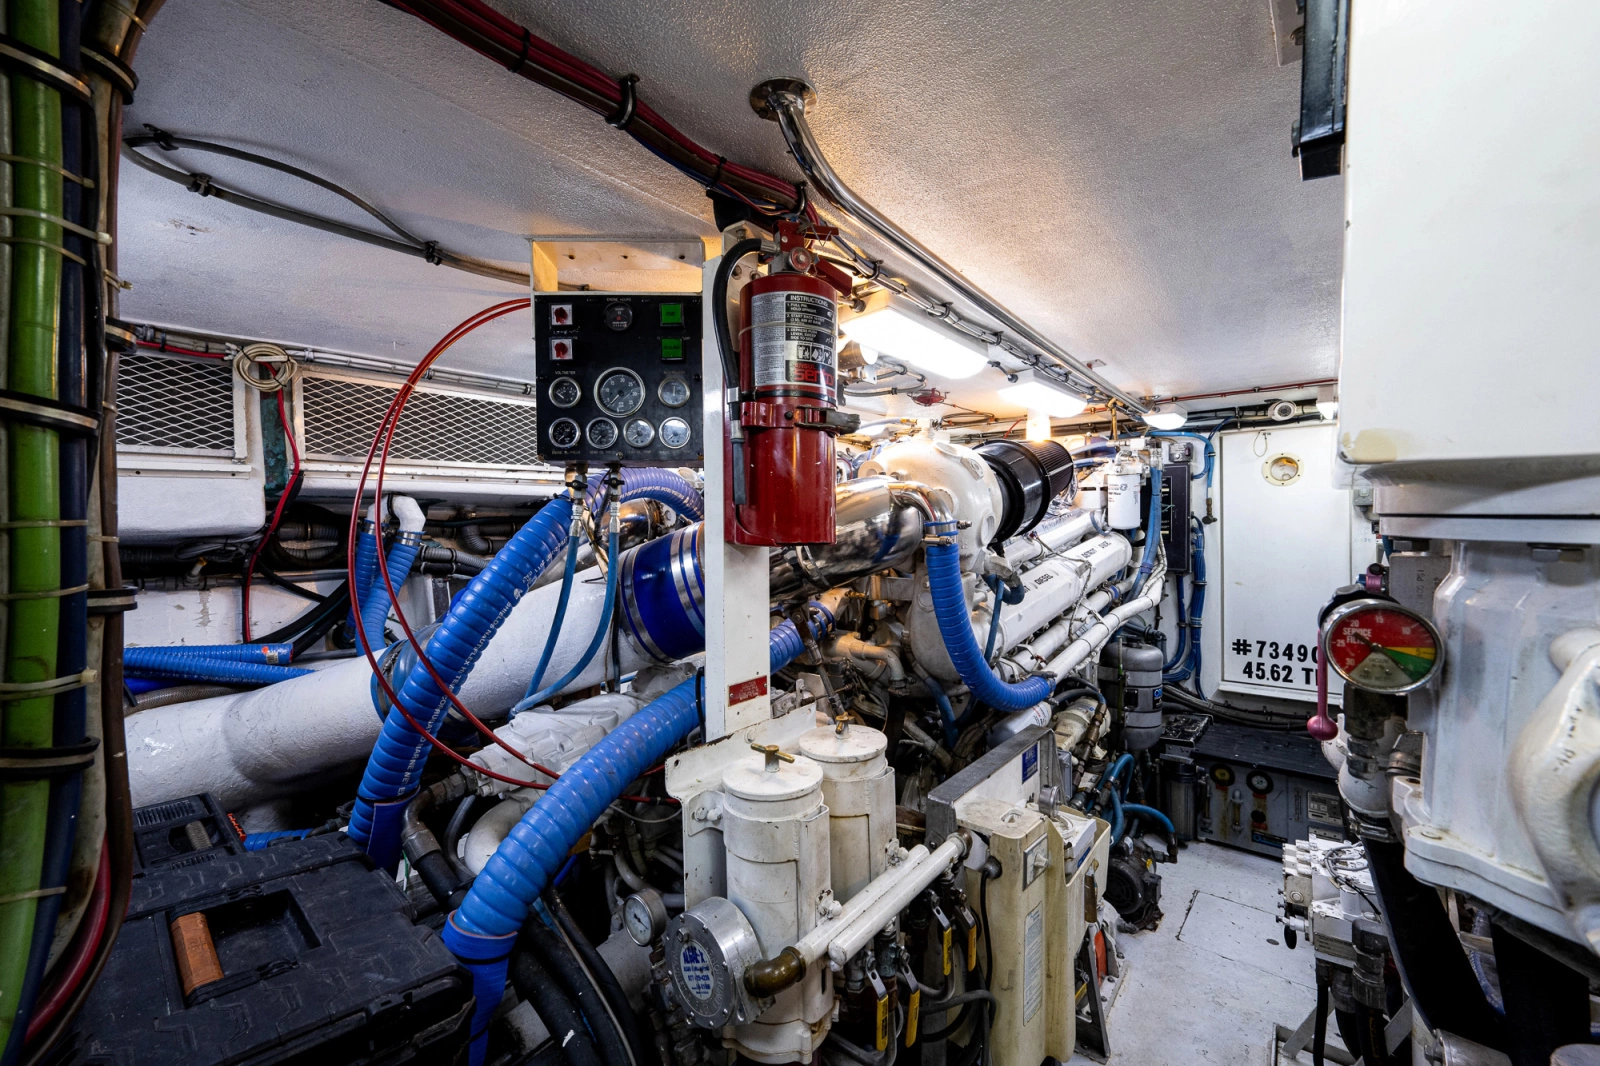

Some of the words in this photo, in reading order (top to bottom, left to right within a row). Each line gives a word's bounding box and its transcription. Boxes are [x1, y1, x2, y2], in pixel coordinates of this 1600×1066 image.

[1342, 627, 1372, 637] SERVICE
[1346, 636, 1369, 645] FIL
[1243, 662, 1294, 683] 45.62
[1302, 668, 1318, 686] T
[418, 693, 448, 743] CORRUGATD
